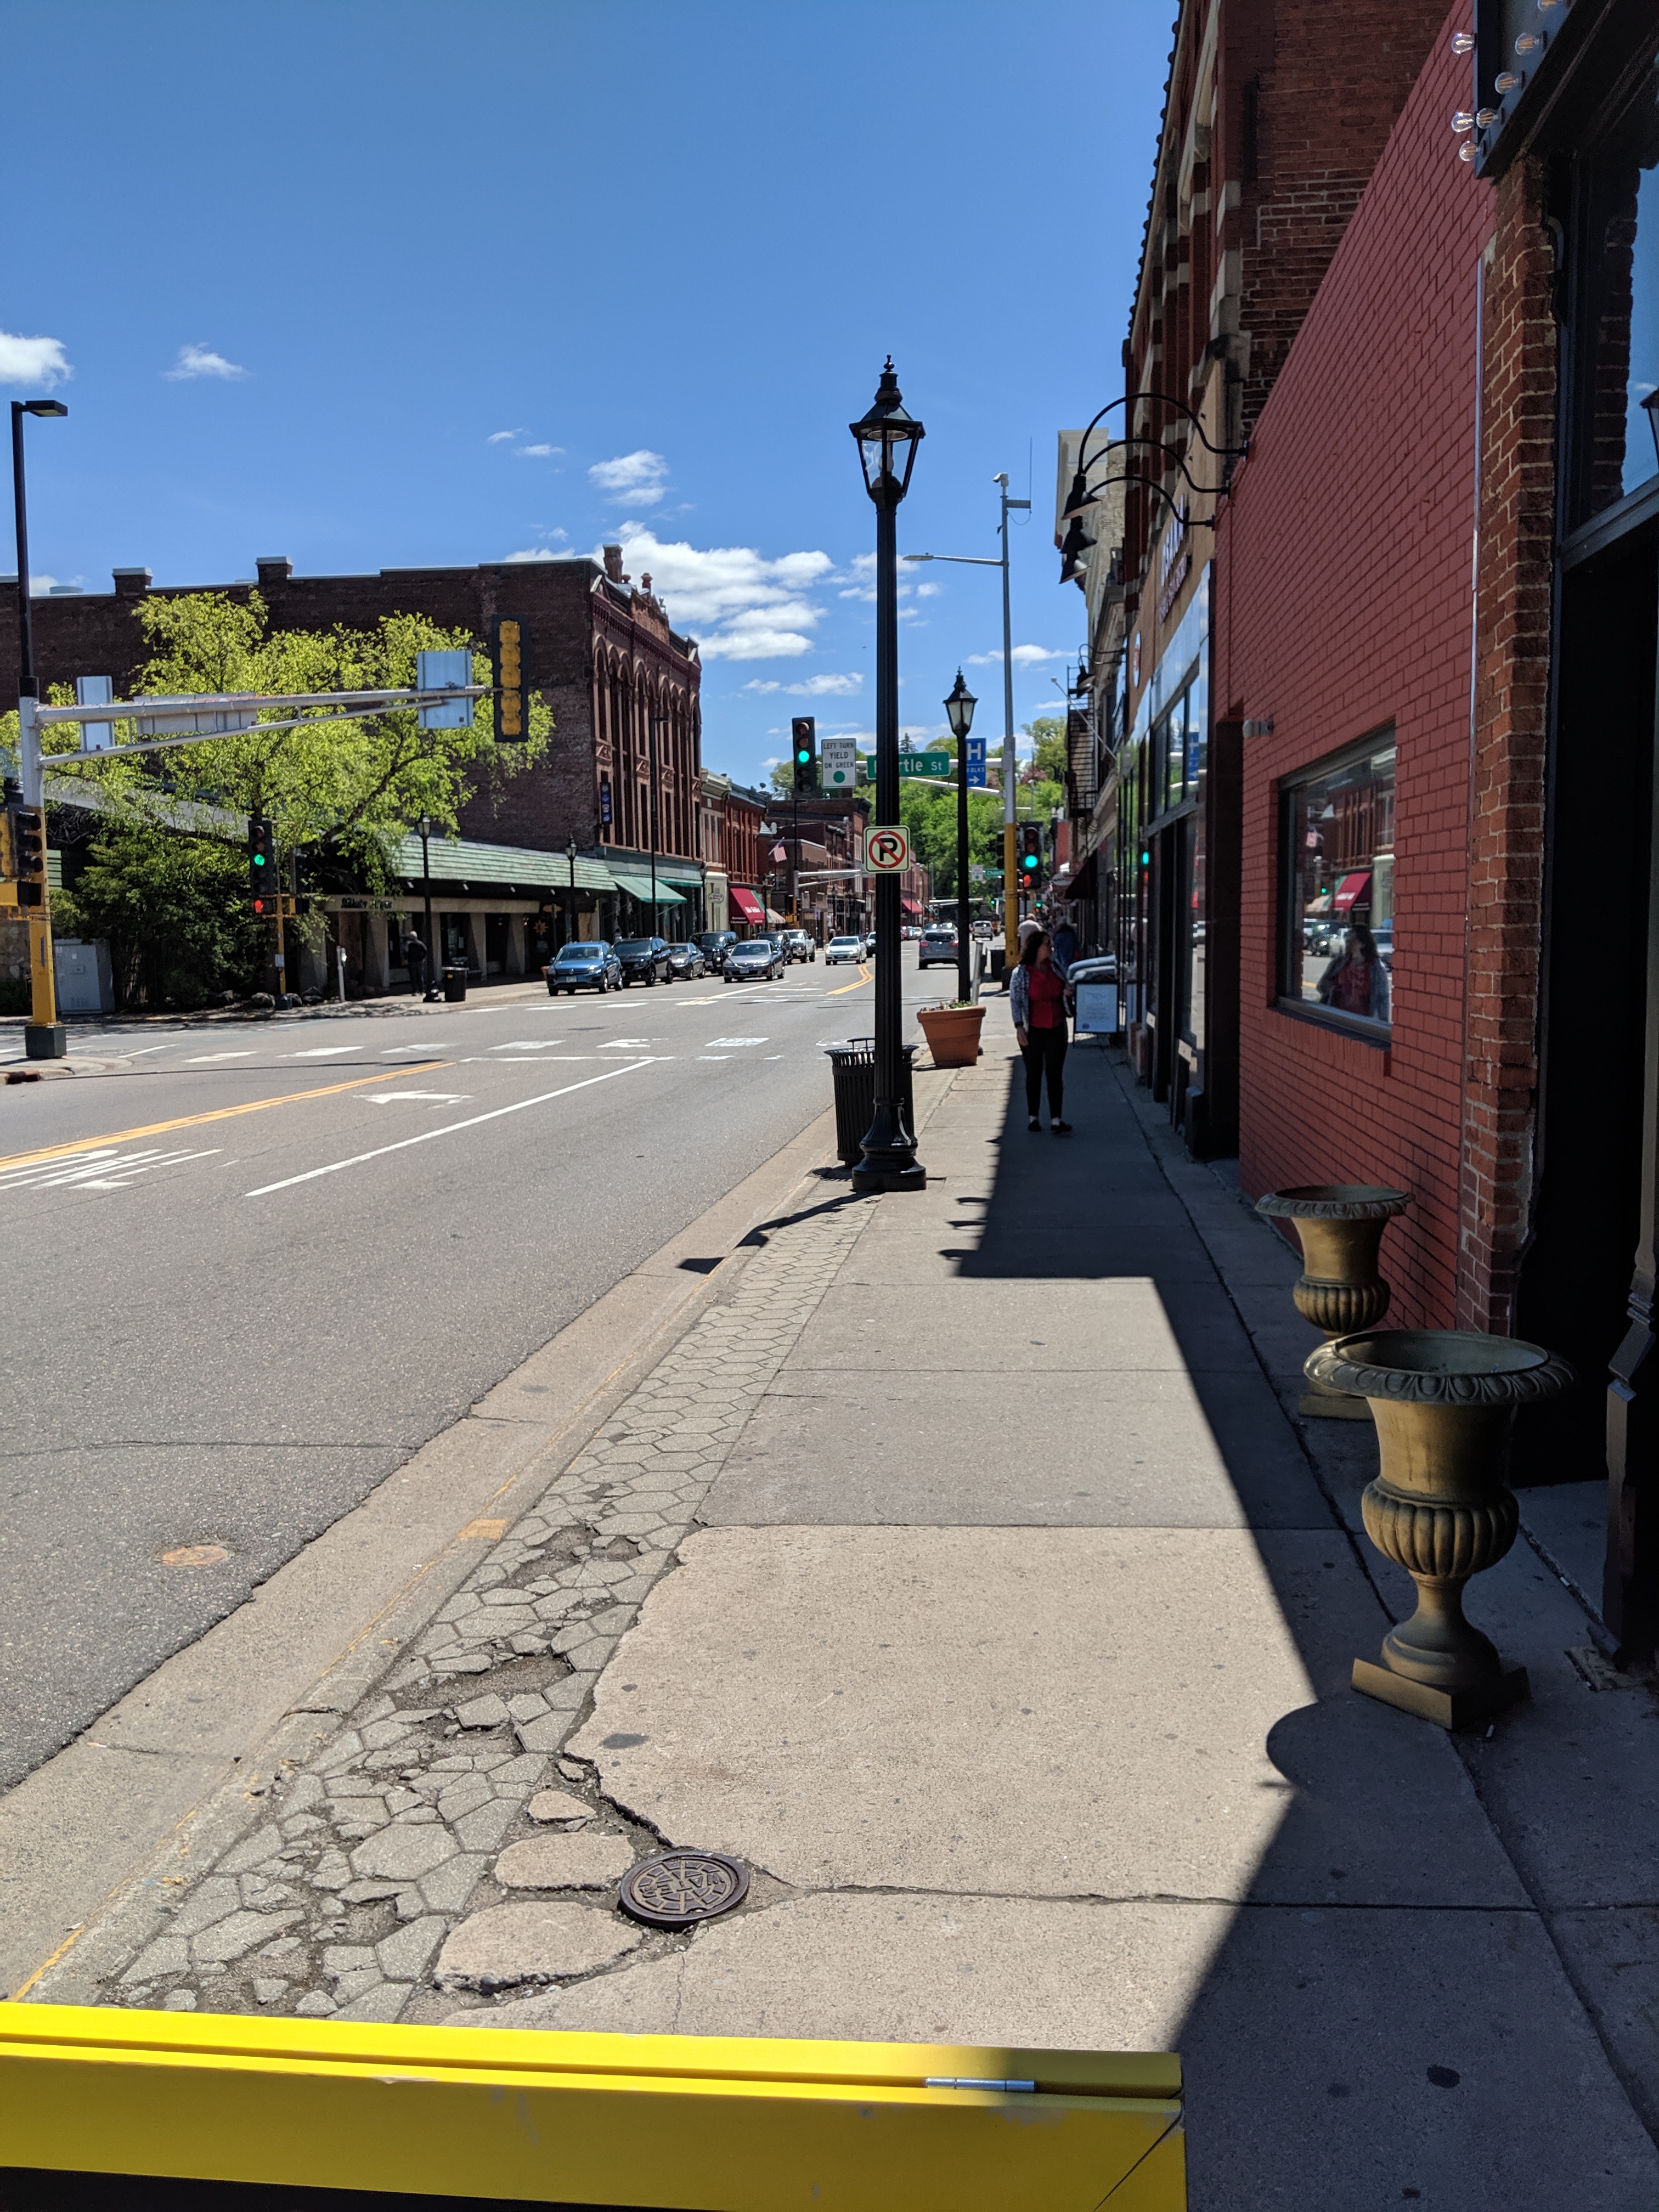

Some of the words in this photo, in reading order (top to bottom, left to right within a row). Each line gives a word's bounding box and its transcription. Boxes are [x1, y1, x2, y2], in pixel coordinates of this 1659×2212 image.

[830, 751, 848, 759] YIELD
[967, 742, 981, 761] H
[639, 1873, 725, 1899] WATER
